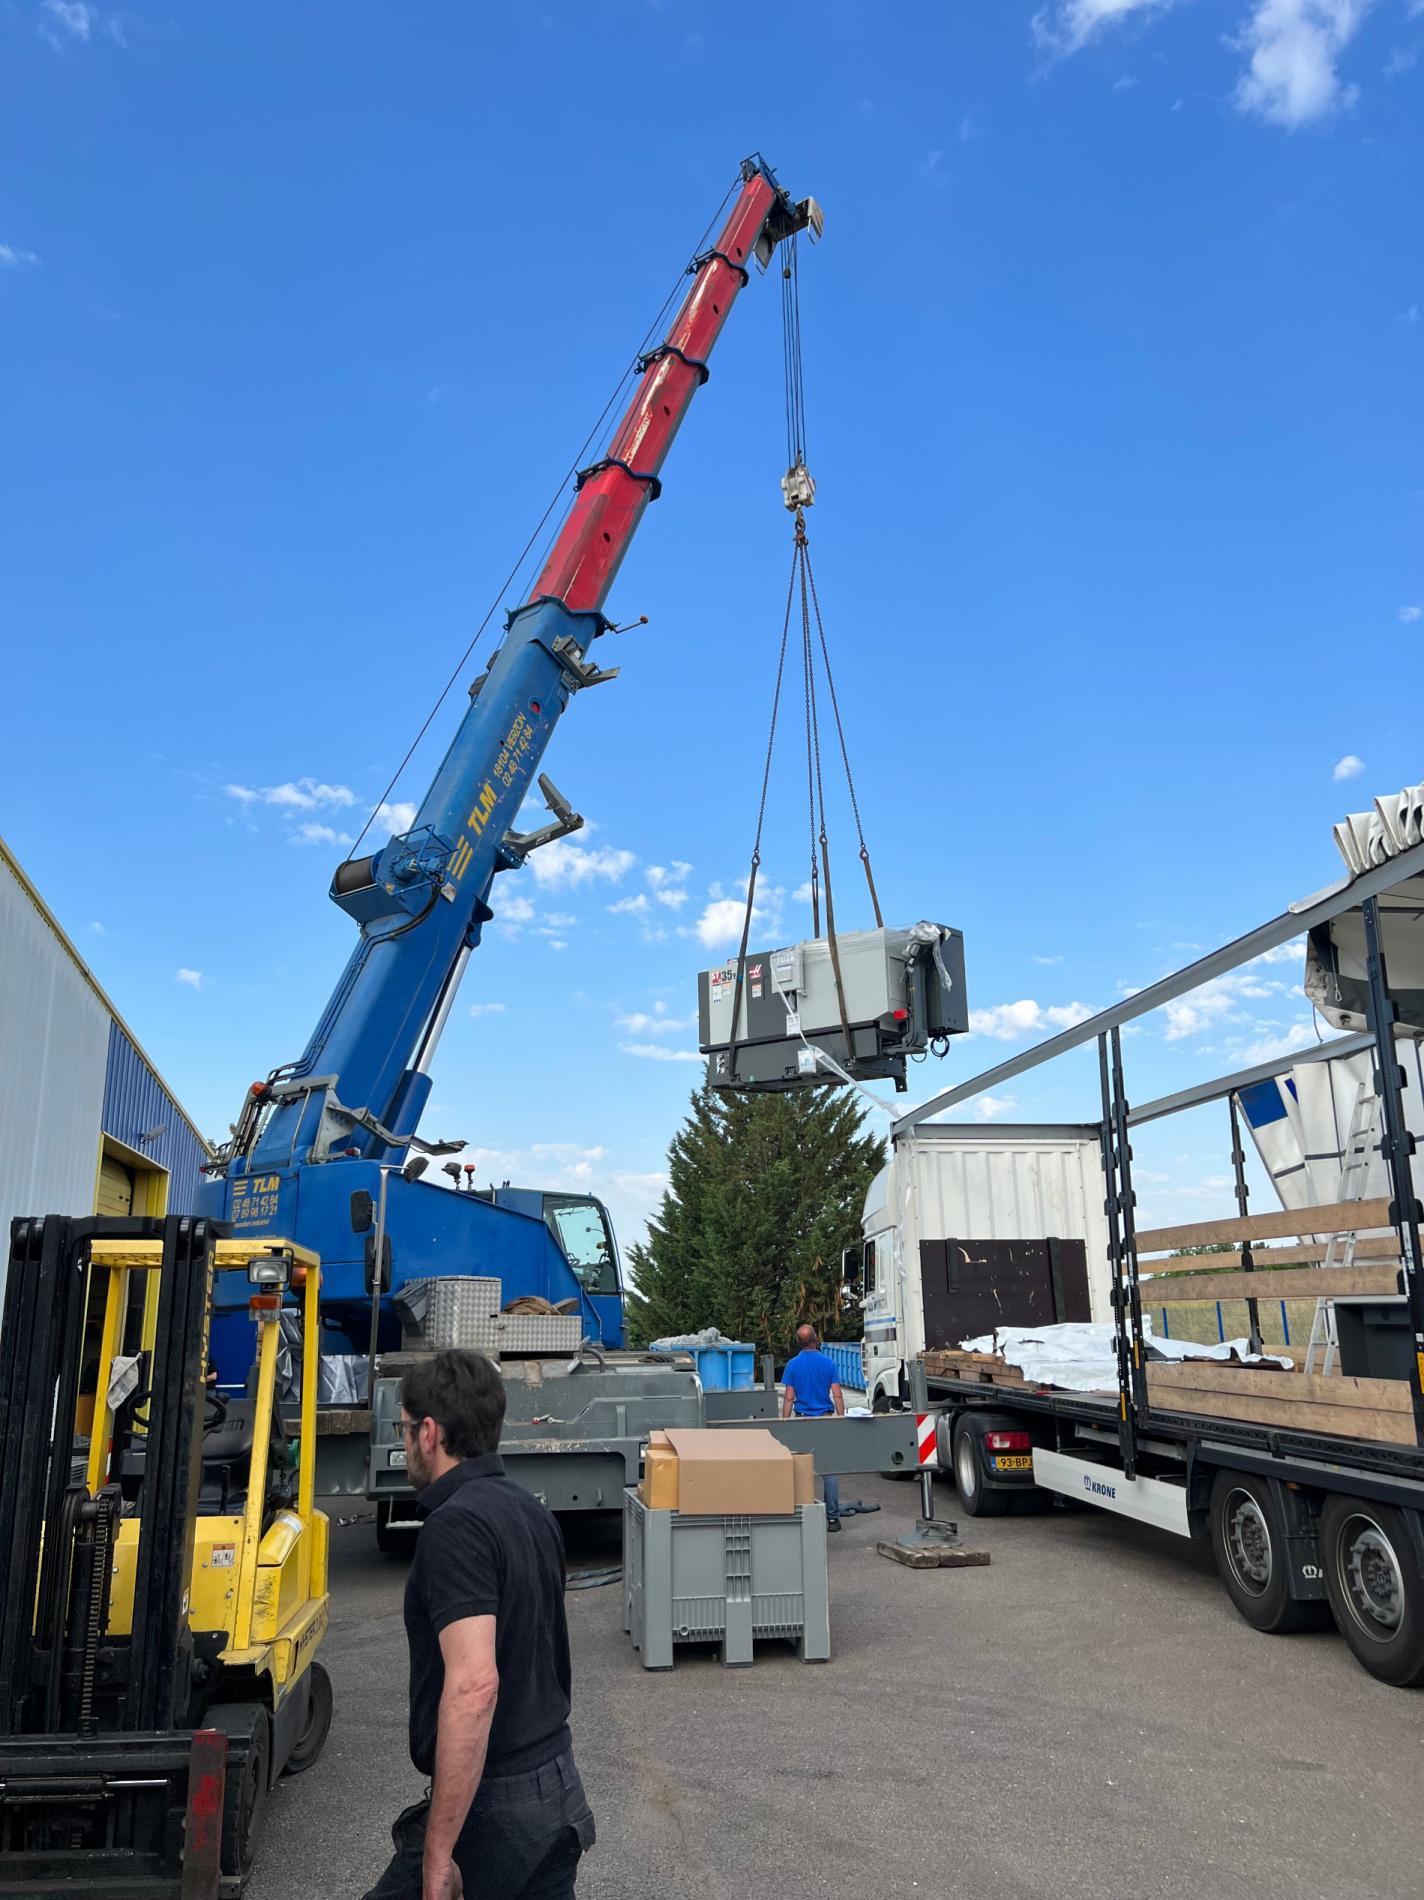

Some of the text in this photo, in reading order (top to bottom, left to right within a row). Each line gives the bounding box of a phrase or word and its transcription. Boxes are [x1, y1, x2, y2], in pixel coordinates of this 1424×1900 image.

[502, 772, 513, 788] 02
[513, 748, 523, 762] 71
[468, 784, 497, 835] TLM
[253, 1176, 280, 1193] TLM
[200, 1250, 214, 1384] HYSTER
[1091, 1481, 1116, 1499] KRONE
